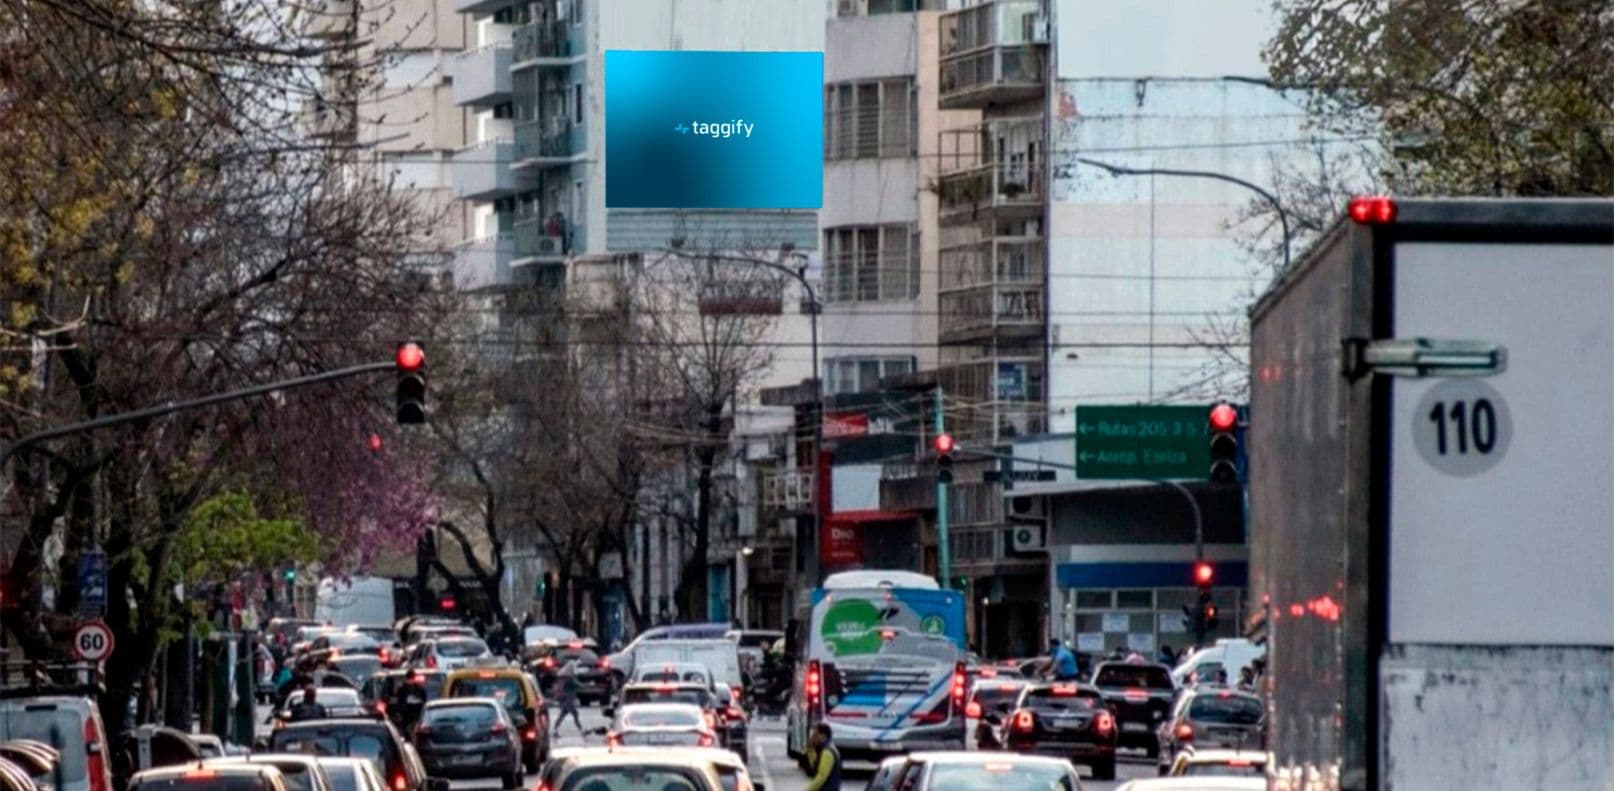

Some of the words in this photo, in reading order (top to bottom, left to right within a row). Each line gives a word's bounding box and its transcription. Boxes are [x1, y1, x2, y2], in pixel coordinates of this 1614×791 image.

[692, 119, 754, 138] taggify
[1429, 398, 1497, 455] 110
[80, 633, 104, 650] 60
